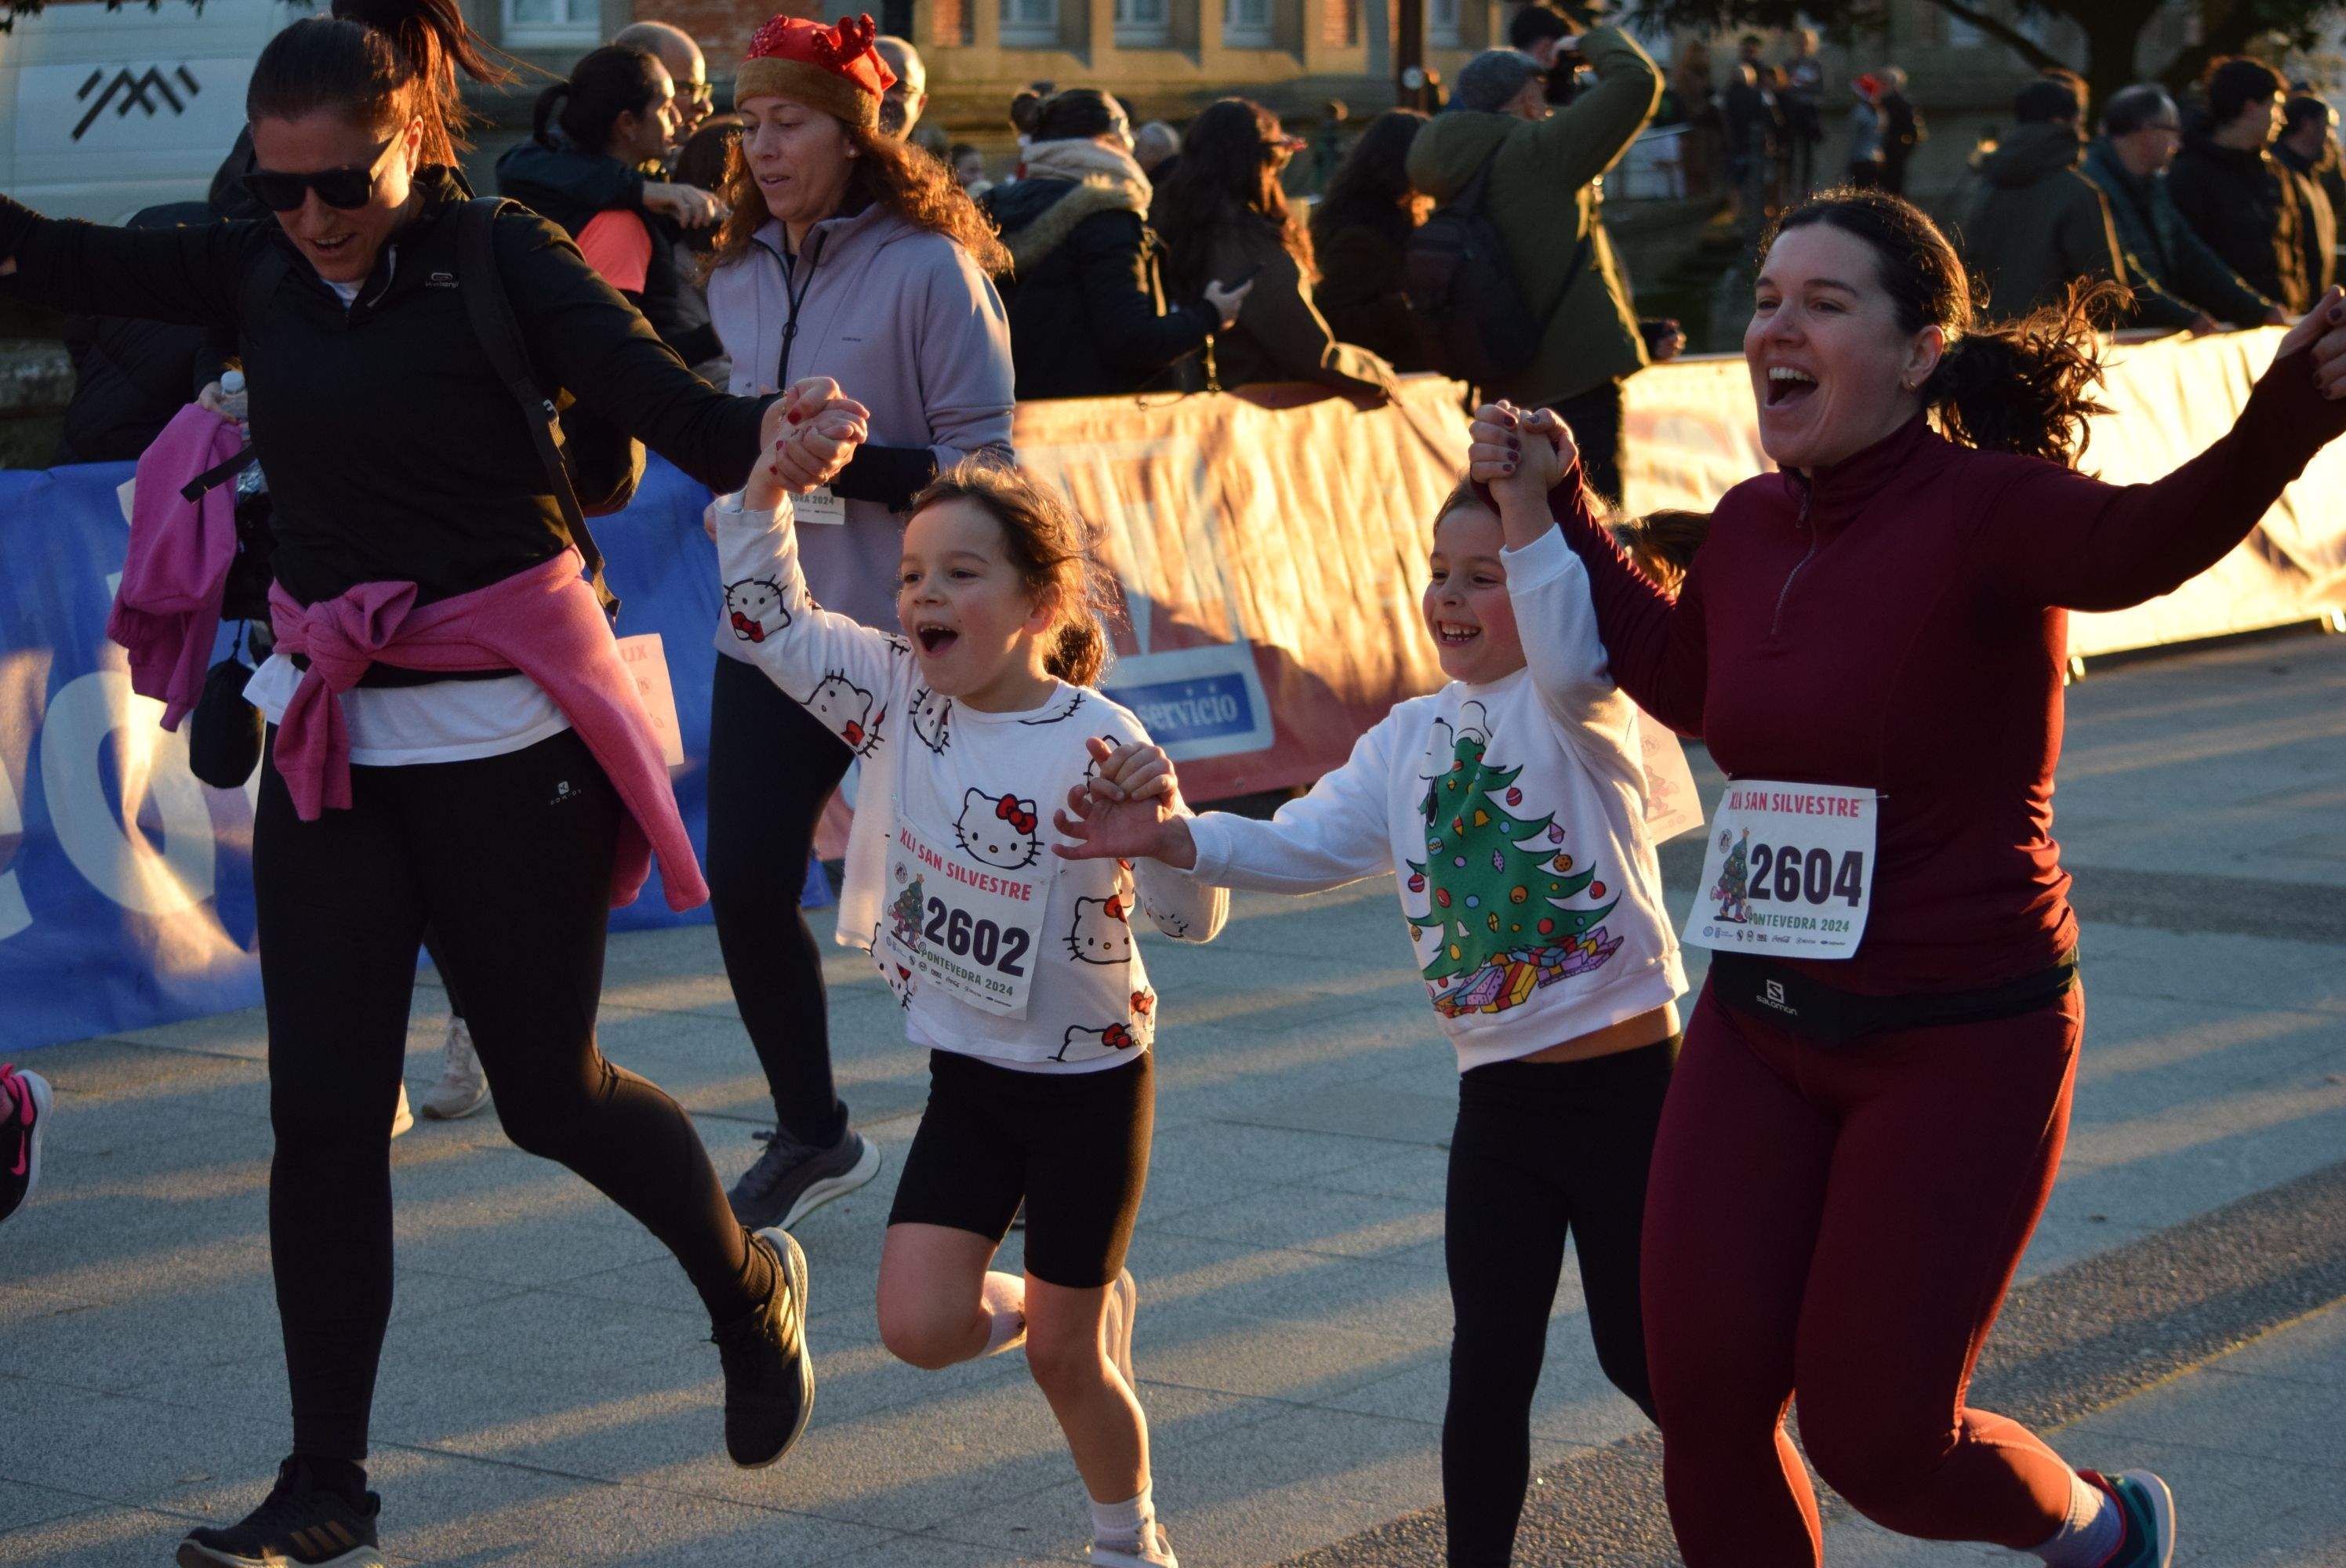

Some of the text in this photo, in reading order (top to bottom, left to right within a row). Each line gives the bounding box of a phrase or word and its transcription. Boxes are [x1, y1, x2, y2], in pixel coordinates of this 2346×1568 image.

[812, 495, 834, 506] 2024
[1136, 684, 1238, 729] servicio
[1728, 791, 1860, 818] XLI SAN SILVESTRE
[900, 826, 1032, 902] XLI SAN SILVESTRE
[1749, 844, 1863, 907] 2604
[924, 896, 1030, 978] 2602
[1749, 913, 1850, 932] PONTEVEDRA 2024
[921, 949, 982, 985] PONTEVEDRA
[985, 978, 1013, 996] 2024
